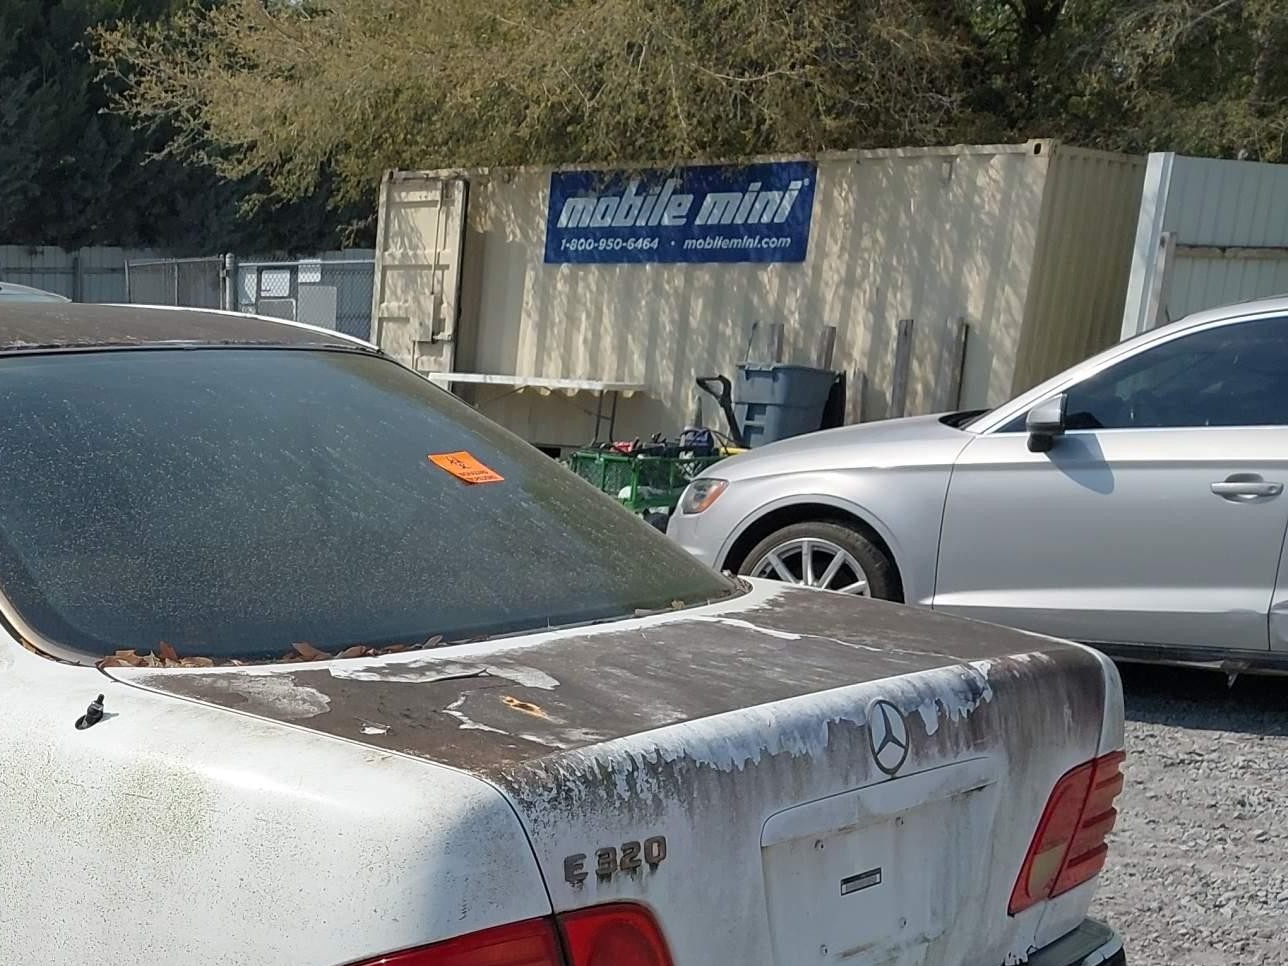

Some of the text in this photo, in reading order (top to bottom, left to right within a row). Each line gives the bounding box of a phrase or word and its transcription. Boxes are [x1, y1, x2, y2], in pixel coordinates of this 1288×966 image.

[557, 178, 694, 228] mobile
[560, 235, 792, 251] 1-800-950-6464 mobilemini.com
[563, 835, 667, 883] E 320
